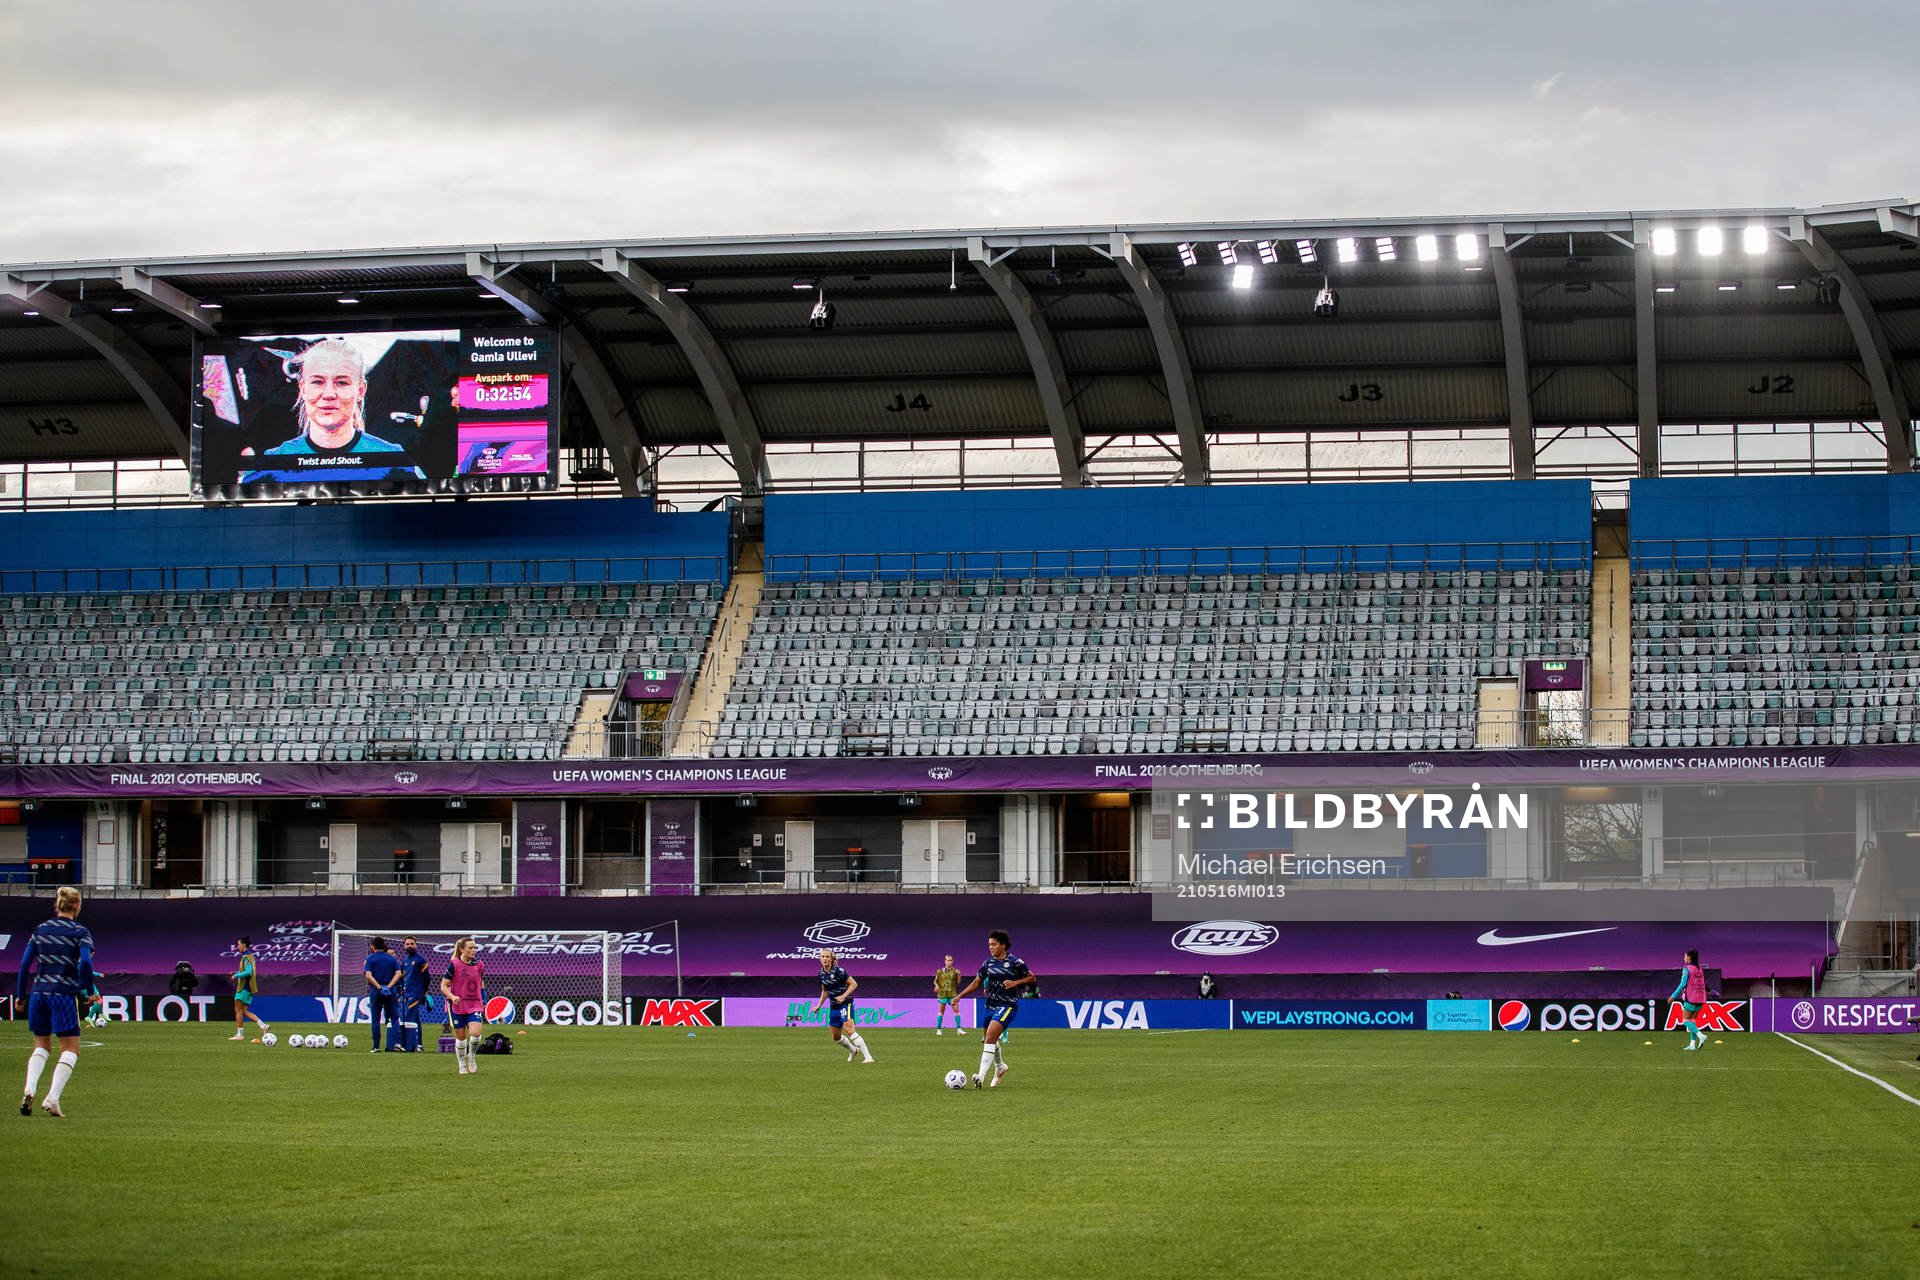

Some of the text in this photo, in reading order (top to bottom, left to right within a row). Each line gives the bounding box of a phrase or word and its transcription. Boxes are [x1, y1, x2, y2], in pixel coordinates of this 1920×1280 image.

[473, 336, 535, 347] Welcome to
[471, 351, 537, 362] Gamla Ullevi
[475, 373, 533, 384] Avspark om:
[1748, 376, 1794, 394] J2
[475, 386, 532, 402] 0:32:54
[1338, 384, 1383, 402] J3
[886, 393, 934, 412] J4
[28, 418, 79, 436] H3
[297, 456, 363, 466] Twist and Shout.
[1095, 764, 1263, 778] FINAL 2021 GOTHENBURG
[1579, 756, 1826, 771] UEFA WOMEN'S CHAMPIONS LEAGUE
[111, 772, 262, 786] FINAL 2021 GOTHENBURG
[553, 768, 787, 782] UEFA WOMEN'S CHAMPIONS LEAGUE
[1180, 928, 1272, 948] Lay's
[766, 952, 889, 961] #WePlaStrong
[795, 946, 867, 954] Togther
[315, 997, 387, 1024] VIS
[524, 997, 719, 1027] pepsi MAX
[1056, 1000, 1150, 1029] VISA
[1241, 1010, 1414, 1025] WEPLAYSTRONG.COM
[1541, 999, 1656, 1032] pepsi
[1823, 1004, 1916, 1026] RESPECT
